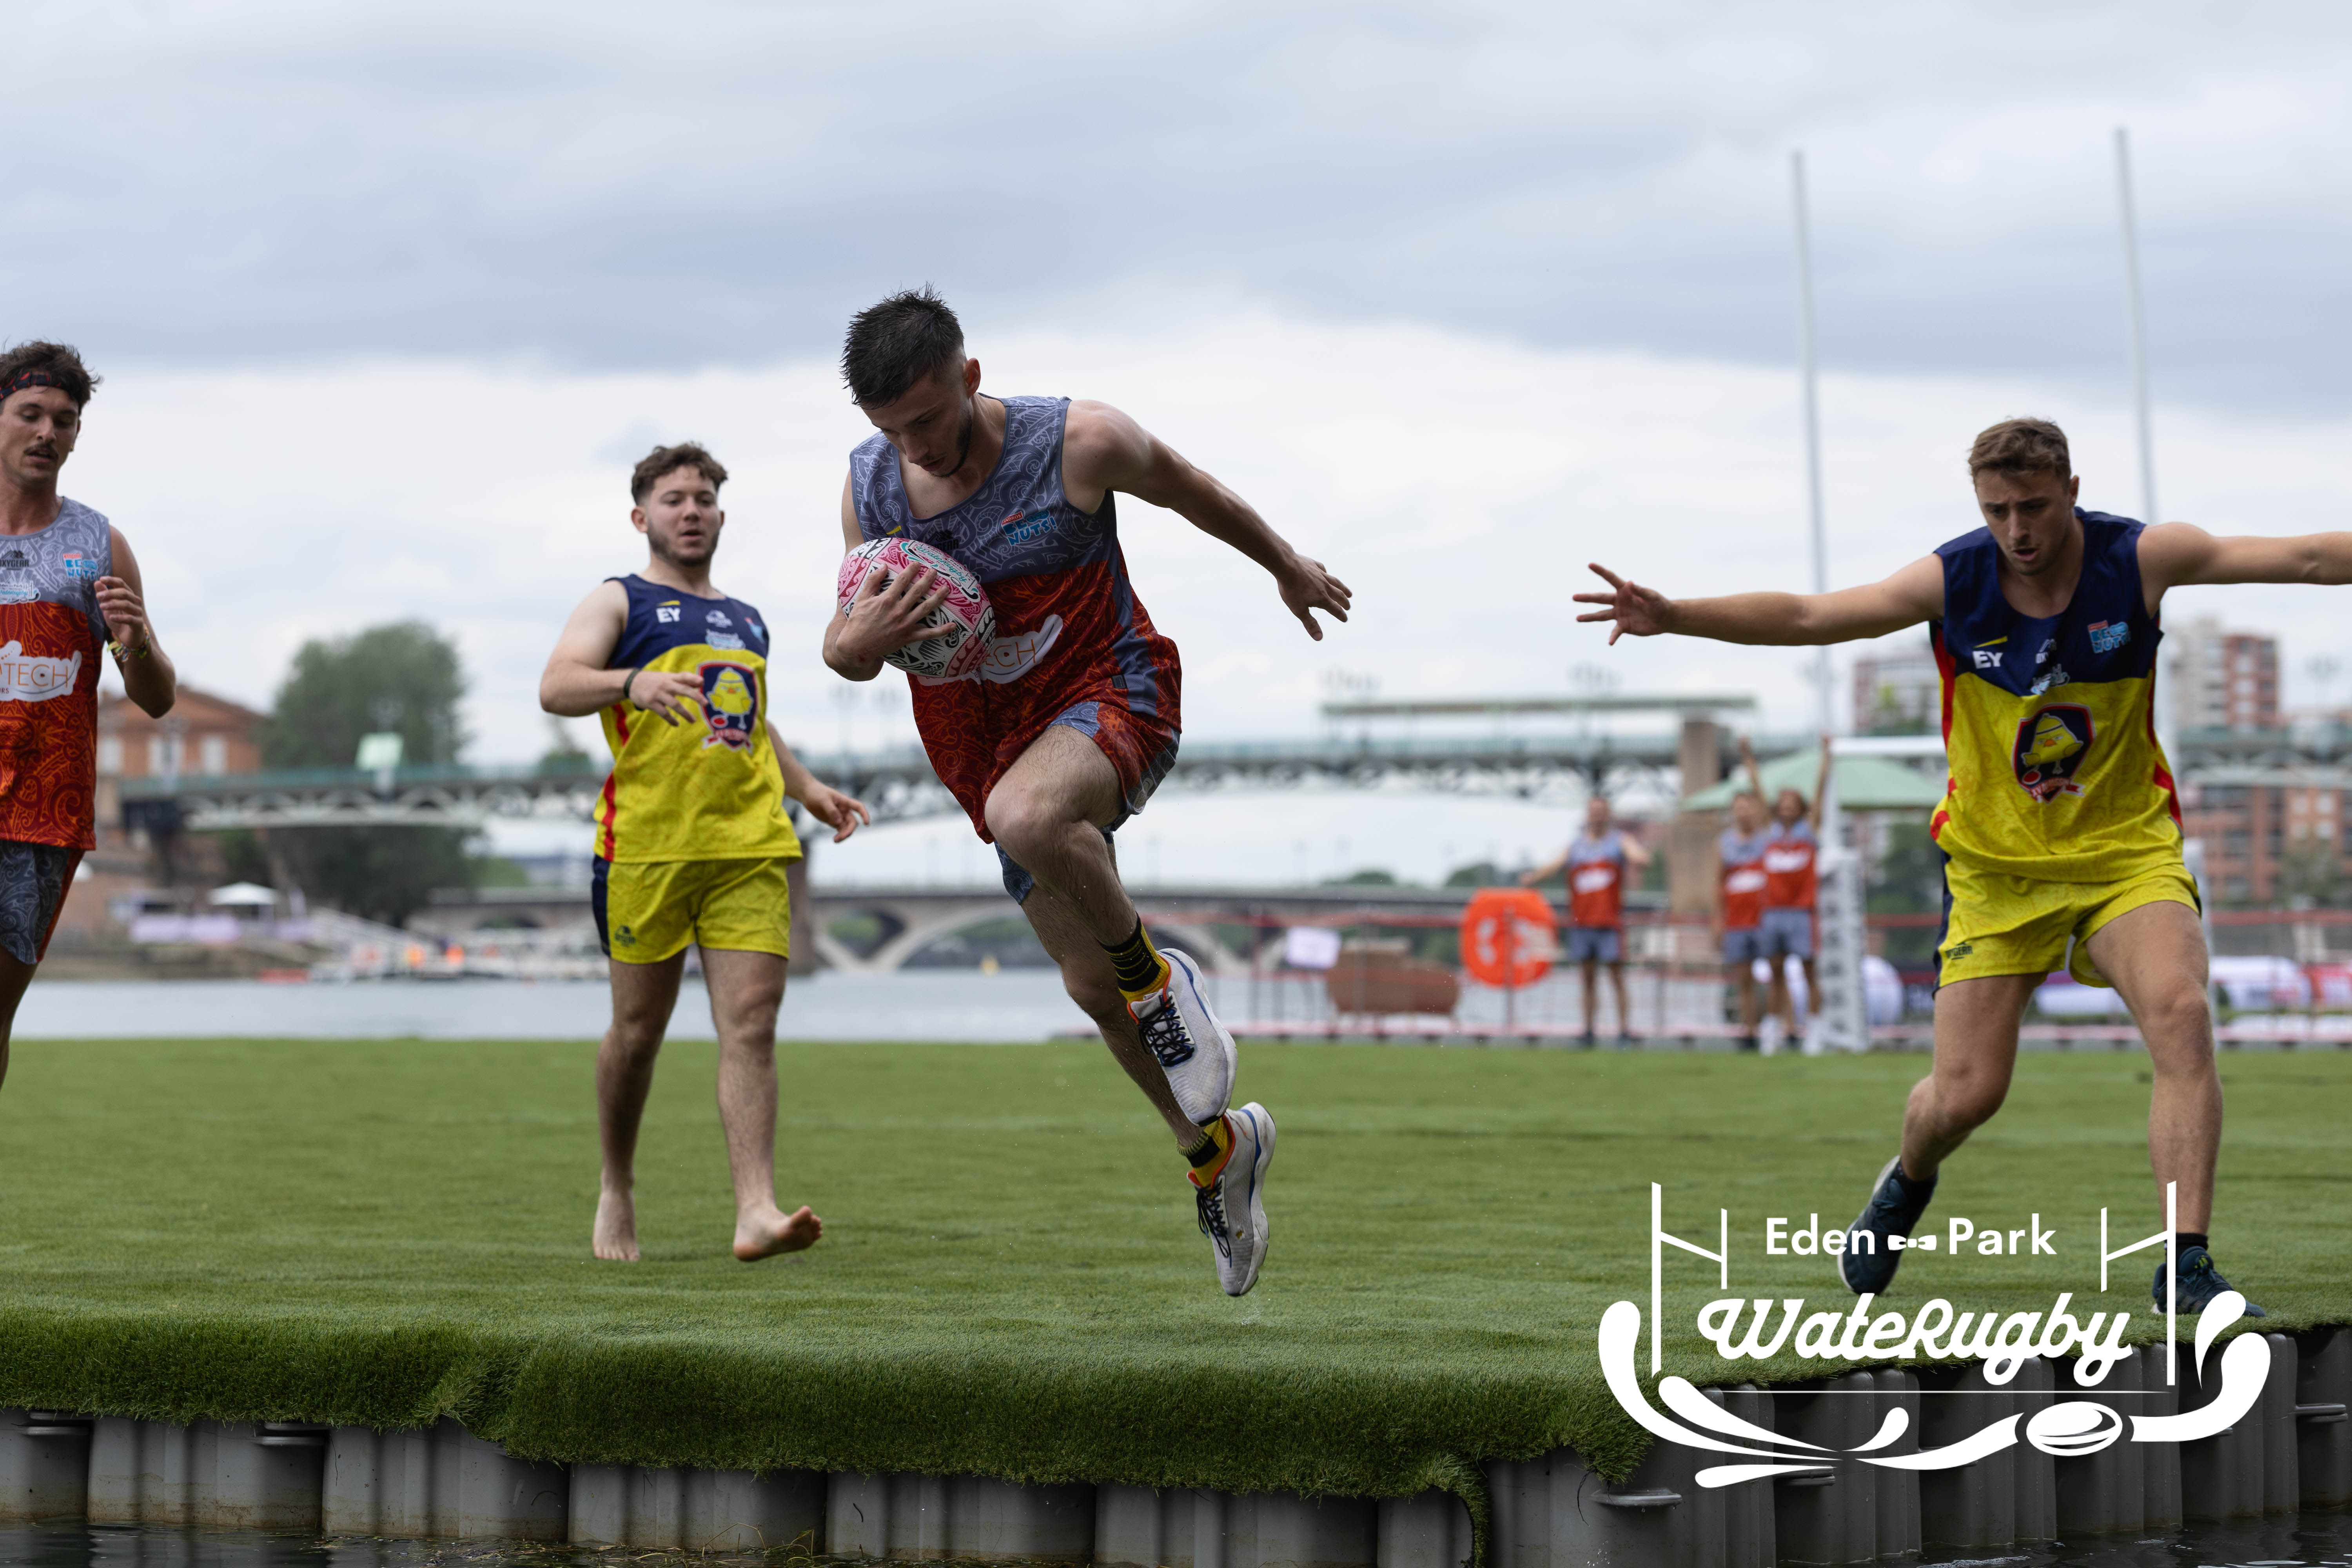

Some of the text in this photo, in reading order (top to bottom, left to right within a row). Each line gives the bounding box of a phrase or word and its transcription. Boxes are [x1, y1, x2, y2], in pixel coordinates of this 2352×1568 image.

[1002, 518, 1028, 535] BE
[1006, 516, 1057, 546] NUTS!
[656, 607, 681, 623] EY
[1972, 650, 2003, 669] EY
